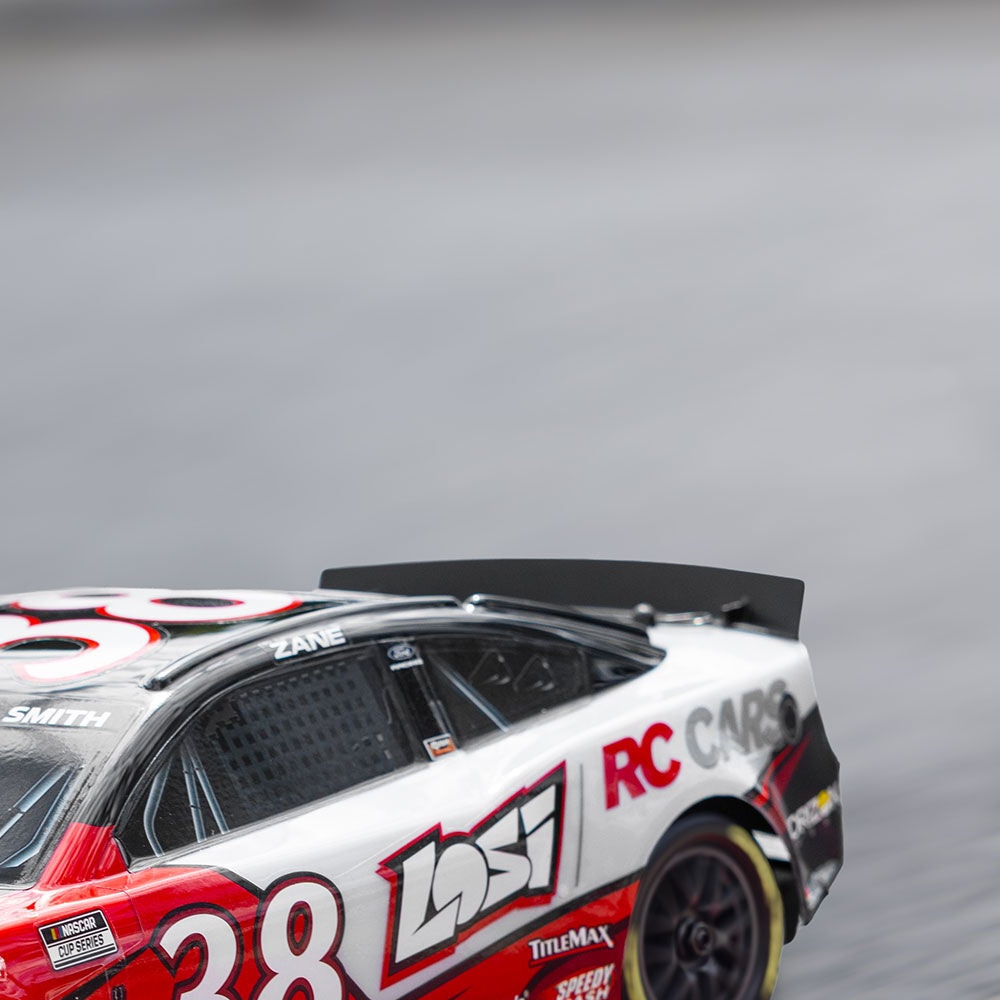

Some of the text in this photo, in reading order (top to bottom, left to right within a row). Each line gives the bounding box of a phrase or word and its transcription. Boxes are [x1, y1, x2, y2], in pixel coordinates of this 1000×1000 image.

[270, 627, 346, 659] ZANE
[2, 706, 111, 727] SMITH
[602, 679, 790, 811] RC CARS
[61, 917, 97, 937] NASCAR
[58, 934, 104, 957] CUP SERIES
